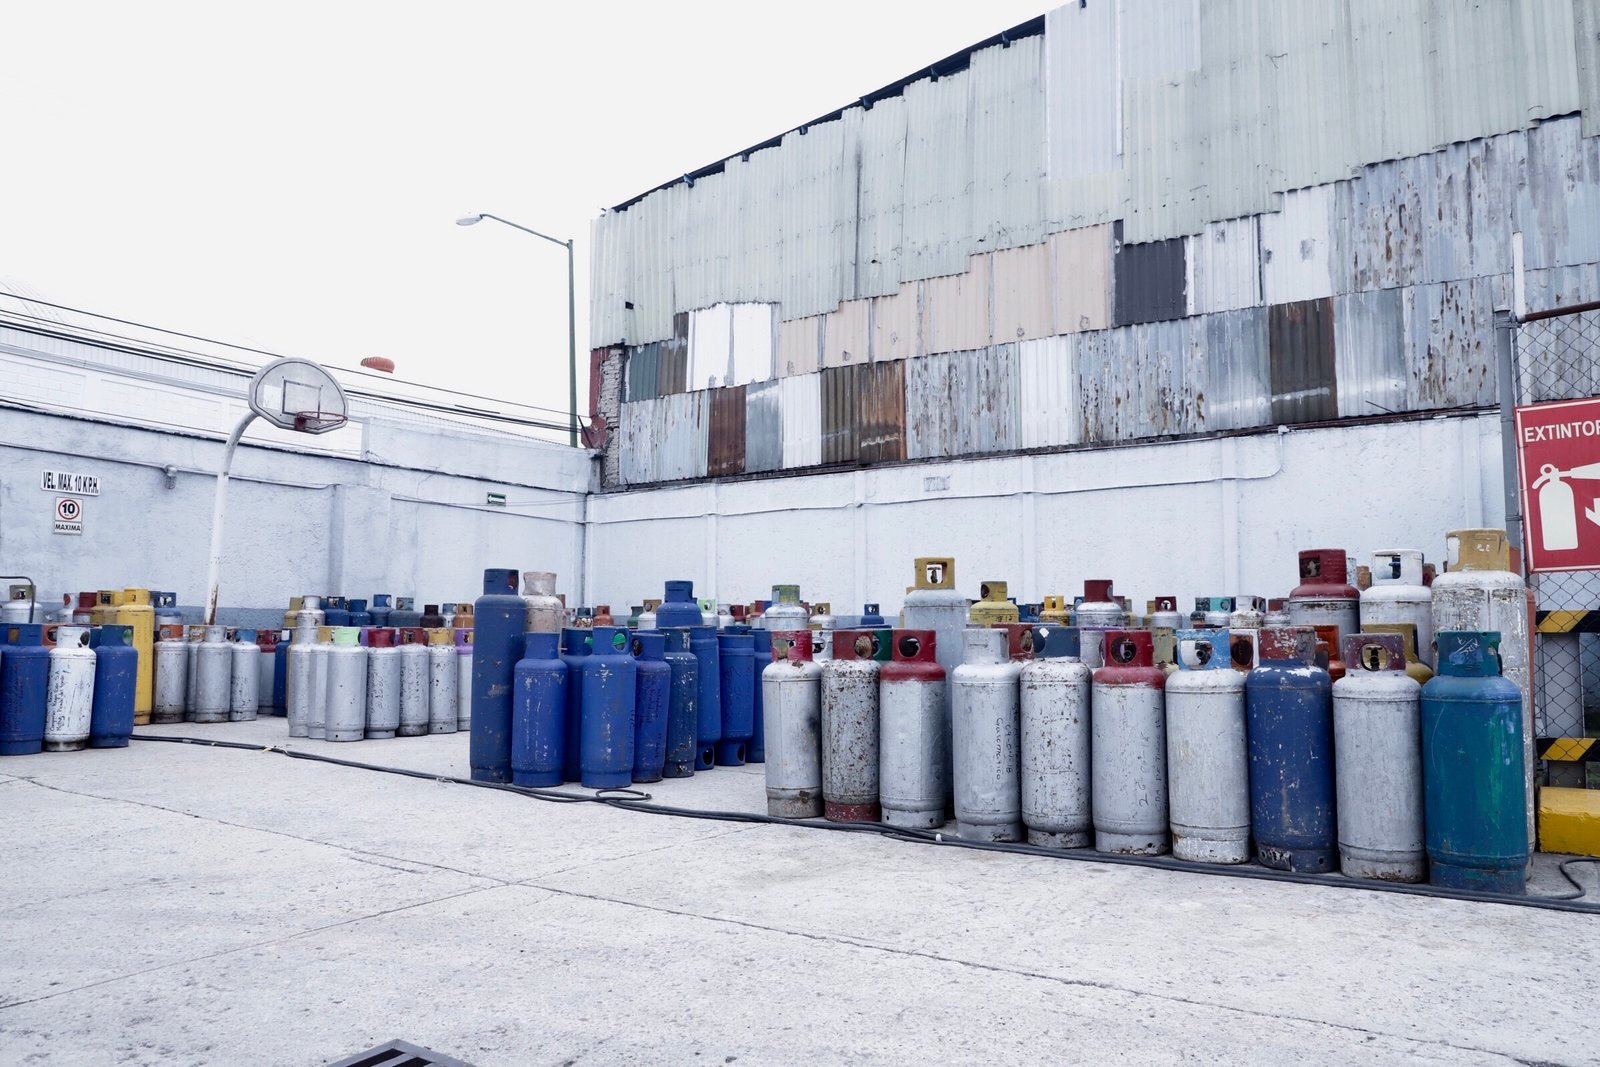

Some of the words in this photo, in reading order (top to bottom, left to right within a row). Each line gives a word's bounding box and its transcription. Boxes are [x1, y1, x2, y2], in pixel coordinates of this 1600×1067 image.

[58, 473, 73, 491] MAX.
[75, 475, 82, 492] 10
[62, 503, 75, 513] 10
